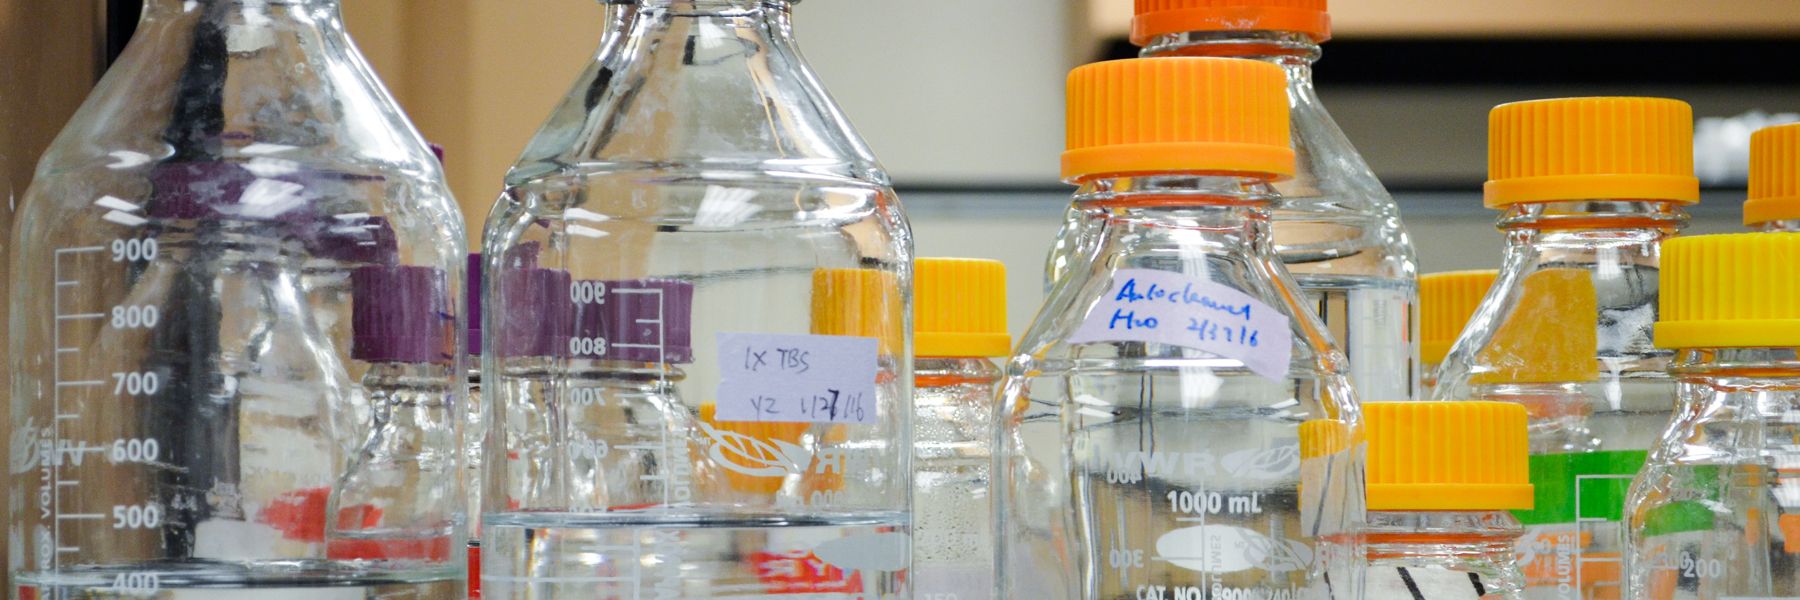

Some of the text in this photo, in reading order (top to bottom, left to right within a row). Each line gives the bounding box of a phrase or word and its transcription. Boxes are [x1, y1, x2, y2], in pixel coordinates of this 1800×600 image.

[112, 238, 157, 261] 900
[112, 305, 157, 328] 800
[777, 348, 809, 374] TBS
[112, 372, 157, 395] 700
[112, 439, 158, 462] 600
[1113, 452, 1217, 476] VWR
[1167, 490, 1262, 514] 1000 mL
[112, 506, 158, 528] 500
[1684, 559, 1721, 577] 200
[112, 573, 159, 596] 400
